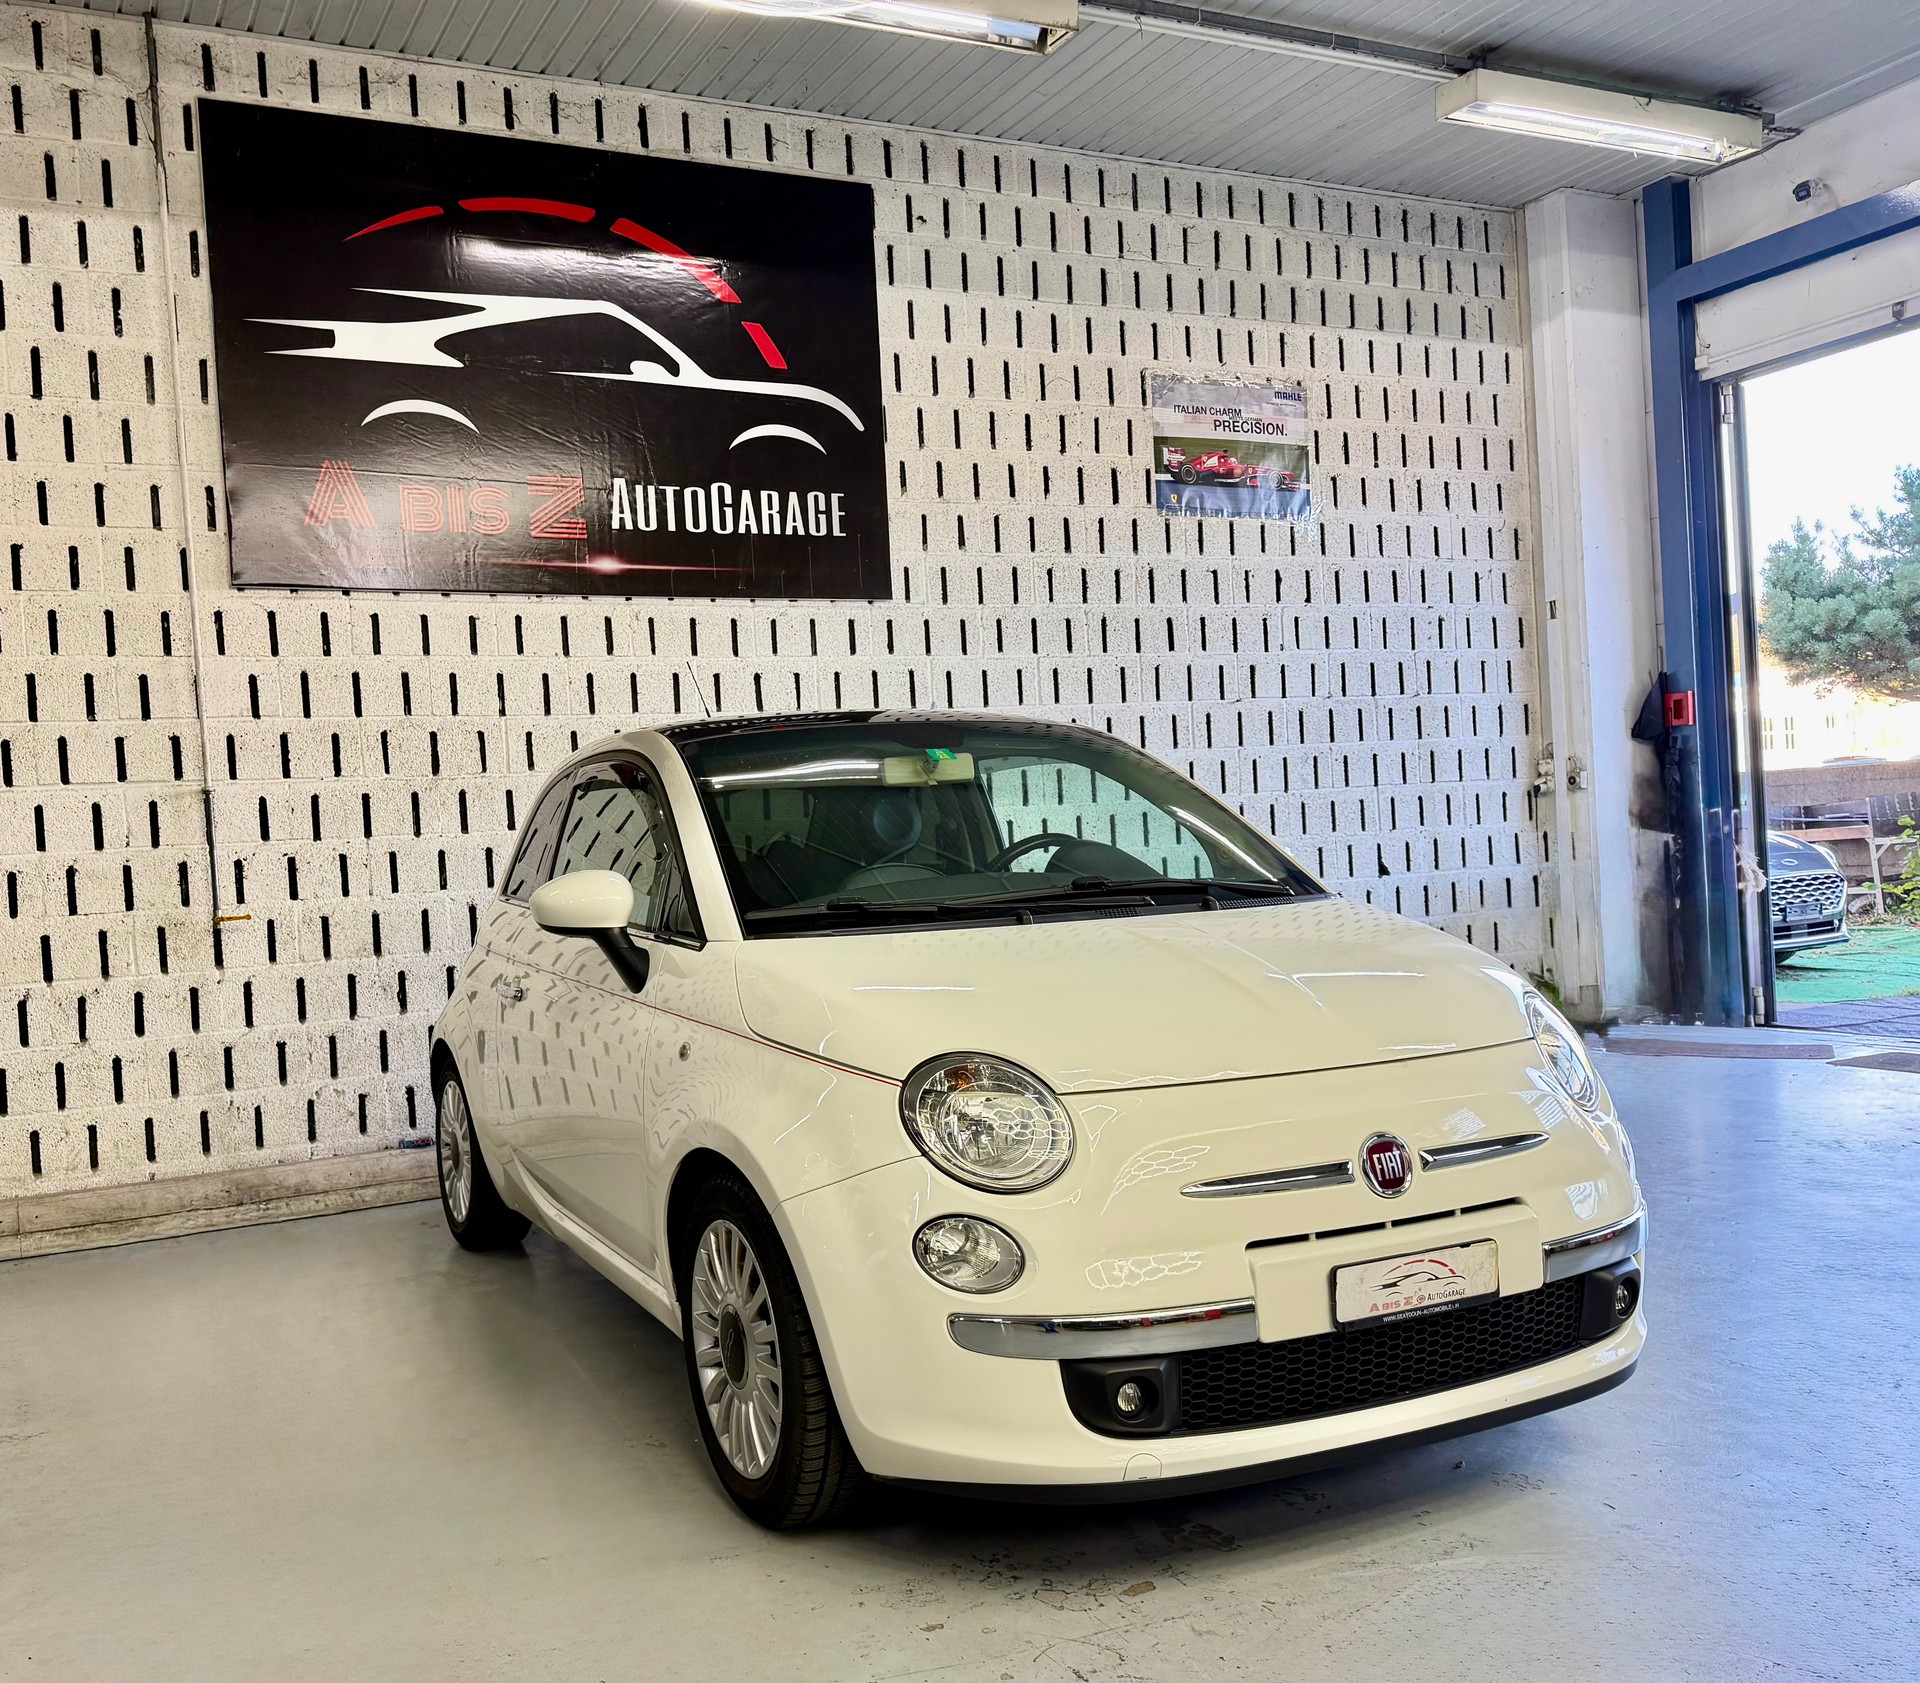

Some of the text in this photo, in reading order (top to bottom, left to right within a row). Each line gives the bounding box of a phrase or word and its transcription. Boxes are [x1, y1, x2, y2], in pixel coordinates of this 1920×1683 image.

[1274, 391, 1302, 402] MAHLE
[1173, 404, 1242, 417] ITALIAN CHARM
[1213, 419, 1288, 437] PRECISION.
[304, 459, 377, 528] A
[399, 484, 511, 535] BIS
[527, 475, 588, 540] Z
[1372, 1147, 1403, 1181] FIAT
[1369, 1302, 1380, 1313] A
[1382, 1300, 1401, 1311] BIS
